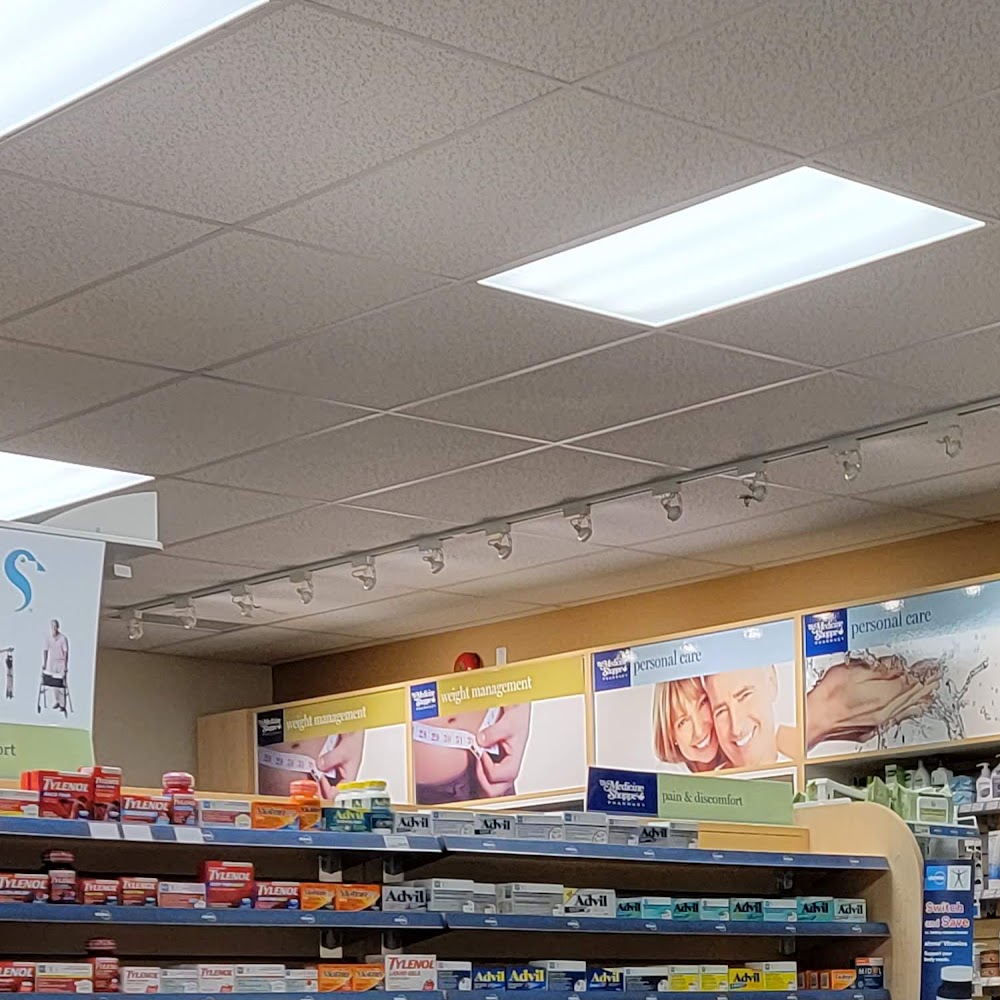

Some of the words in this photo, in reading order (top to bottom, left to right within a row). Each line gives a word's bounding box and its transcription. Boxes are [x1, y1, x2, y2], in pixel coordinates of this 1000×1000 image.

[851, 610, 901, 639] personal
[905, 610, 932, 626] care
[633, 650, 677, 676] personal
[679, 650, 702, 663] care
[441, 685, 470, 704] weight
[471, 676, 533, 698] management
[286, 715, 312, 731] weight
[313, 706, 367, 726] management
[42, 777, 89, 792] TYLENOL
[124, 797, 169, 812] TYLENOL
[662, 791, 682, 803] pain
[684, 791, 694, 803] &
[694, 791, 743, 807] discomfort
[335, 809, 364, 820] Advil
[399, 816, 430, 829] Advil
[481, 818, 511, 831] Advil
[641, 826, 668, 839] Advil
[209, 868, 251, 881] TYLENOL
[0, 876, 47, 890] TYLENOL
[84, 881, 118, 892] TYLENOL
[123, 879, 156, 890] TYLENOL
[258, 884, 299, 896] TYLENOL
[386, 889, 424, 904] Advil
[574, 894, 608, 907] Advil
[617, 902, 641, 913] Advil
[674, 902, 699, 913] Advil
[733, 901, 762, 914] Advil
[802, 902, 829, 914] Advil
[838, 904, 863, 915] Advil
[925, 901, 964, 914] Switch
[924, 918, 941, 928] and
[941, 915, 970, 928] Save
[388, 957, 435, 970] TYLENOL
[127, 970, 158, 979] TYLENOL
[201, 968, 233, 977] TYLENOL
[474, 971, 505, 982] Advil
[508, 969, 545, 983] Advil
[591, 971, 620, 983] Advil
[733, 972, 760, 983] Advil
[858, 967, 882, 975] MIDOL
